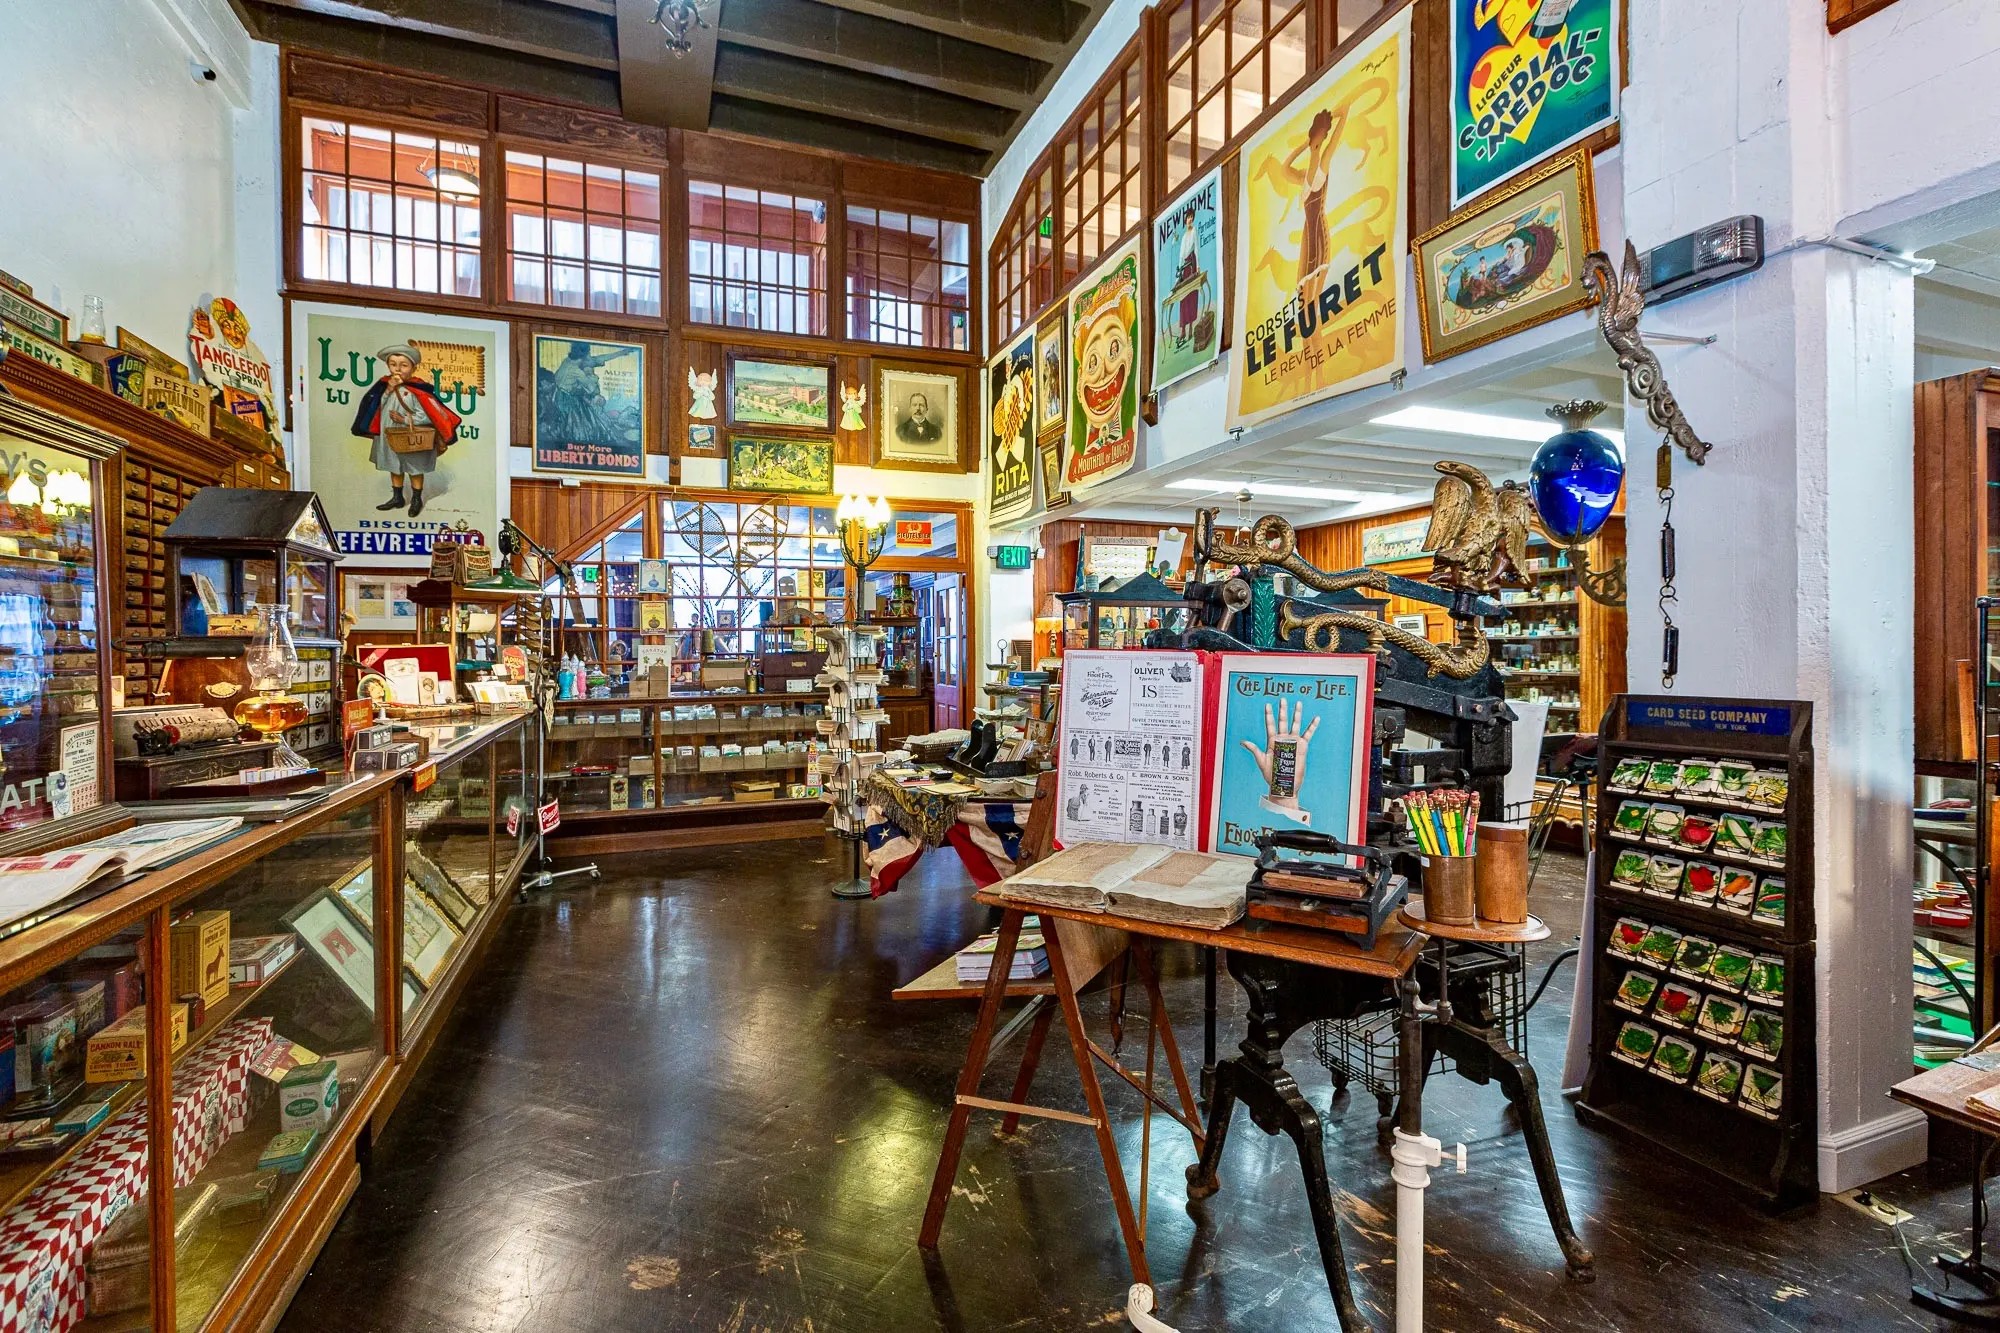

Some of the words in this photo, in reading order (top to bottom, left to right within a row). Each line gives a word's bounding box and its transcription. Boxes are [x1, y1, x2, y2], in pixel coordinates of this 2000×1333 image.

[1459, 27, 1603, 150] CORDIAL-
[1475, 53, 1523, 112] LIQUEUR
[1160, 208, 1181, 252] NEW
[1182, 181, 1215, 229] HOME
[1246, 333, 1277, 377] LE
[1284, 241, 1387, 354] FURET
[1245, 291, 1305, 348] CORSETS
[1264, 368, 1277, 386] LE
[1311, 350, 1325, 370] DE
[1327, 337, 1344, 358] LA
[1347, 298, 1397, 345] FEMME
[189, 334, 272, 393] TANGLEFOOT
[317, 336, 377, 388] LU
[212, 363, 231, 377] FLY
[236, 371, 263, 389] SPRAY
[153, 375, 200, 399] PEET'S
[326, 387, 351, 405] LU
[431, 367, 479, 416] LU
[407, 434, 424, 446] LU
[459, 424, 480, 440] LU
[567, 443, 586, 453] Buy
[588, 444, 612, 453] More
[539, 449, 596, 465] LIBERTY
[597, 453, 640, 468] BONDS
[1078, 451, 1106, 475] MOUTHFUL
[995, 460, 1030, 497] RITA
[358, 519, 449, 531] BISCUITS
[467, 556, 490, 565] WONDER
[1003, 546, 1028, 566] EXIT
[1134, 667, 1165, 677] OLIVER
[1141, 684, 1158, 699] IS
[1236, 675, 1262, 697] THE
[1263, 676, 1295, 697] LINE
[1314, 679, 1352, 700] LIFE.
[1647, 707, 1675, 719] CARD
[1678, 708, 1706, 721] SEED
[1710, 710, 1768, 724] COMPANY
[73, 730, 85, 740] YOUR
[84, 728, 96, 738] LUCK
[1714, 723, 1728, 731] NEW
[1730, 724, 1748, 732] YORK
[1084, 770, 1108, 780] Roberts
[1140, 772, 1162, 780] BROWN
